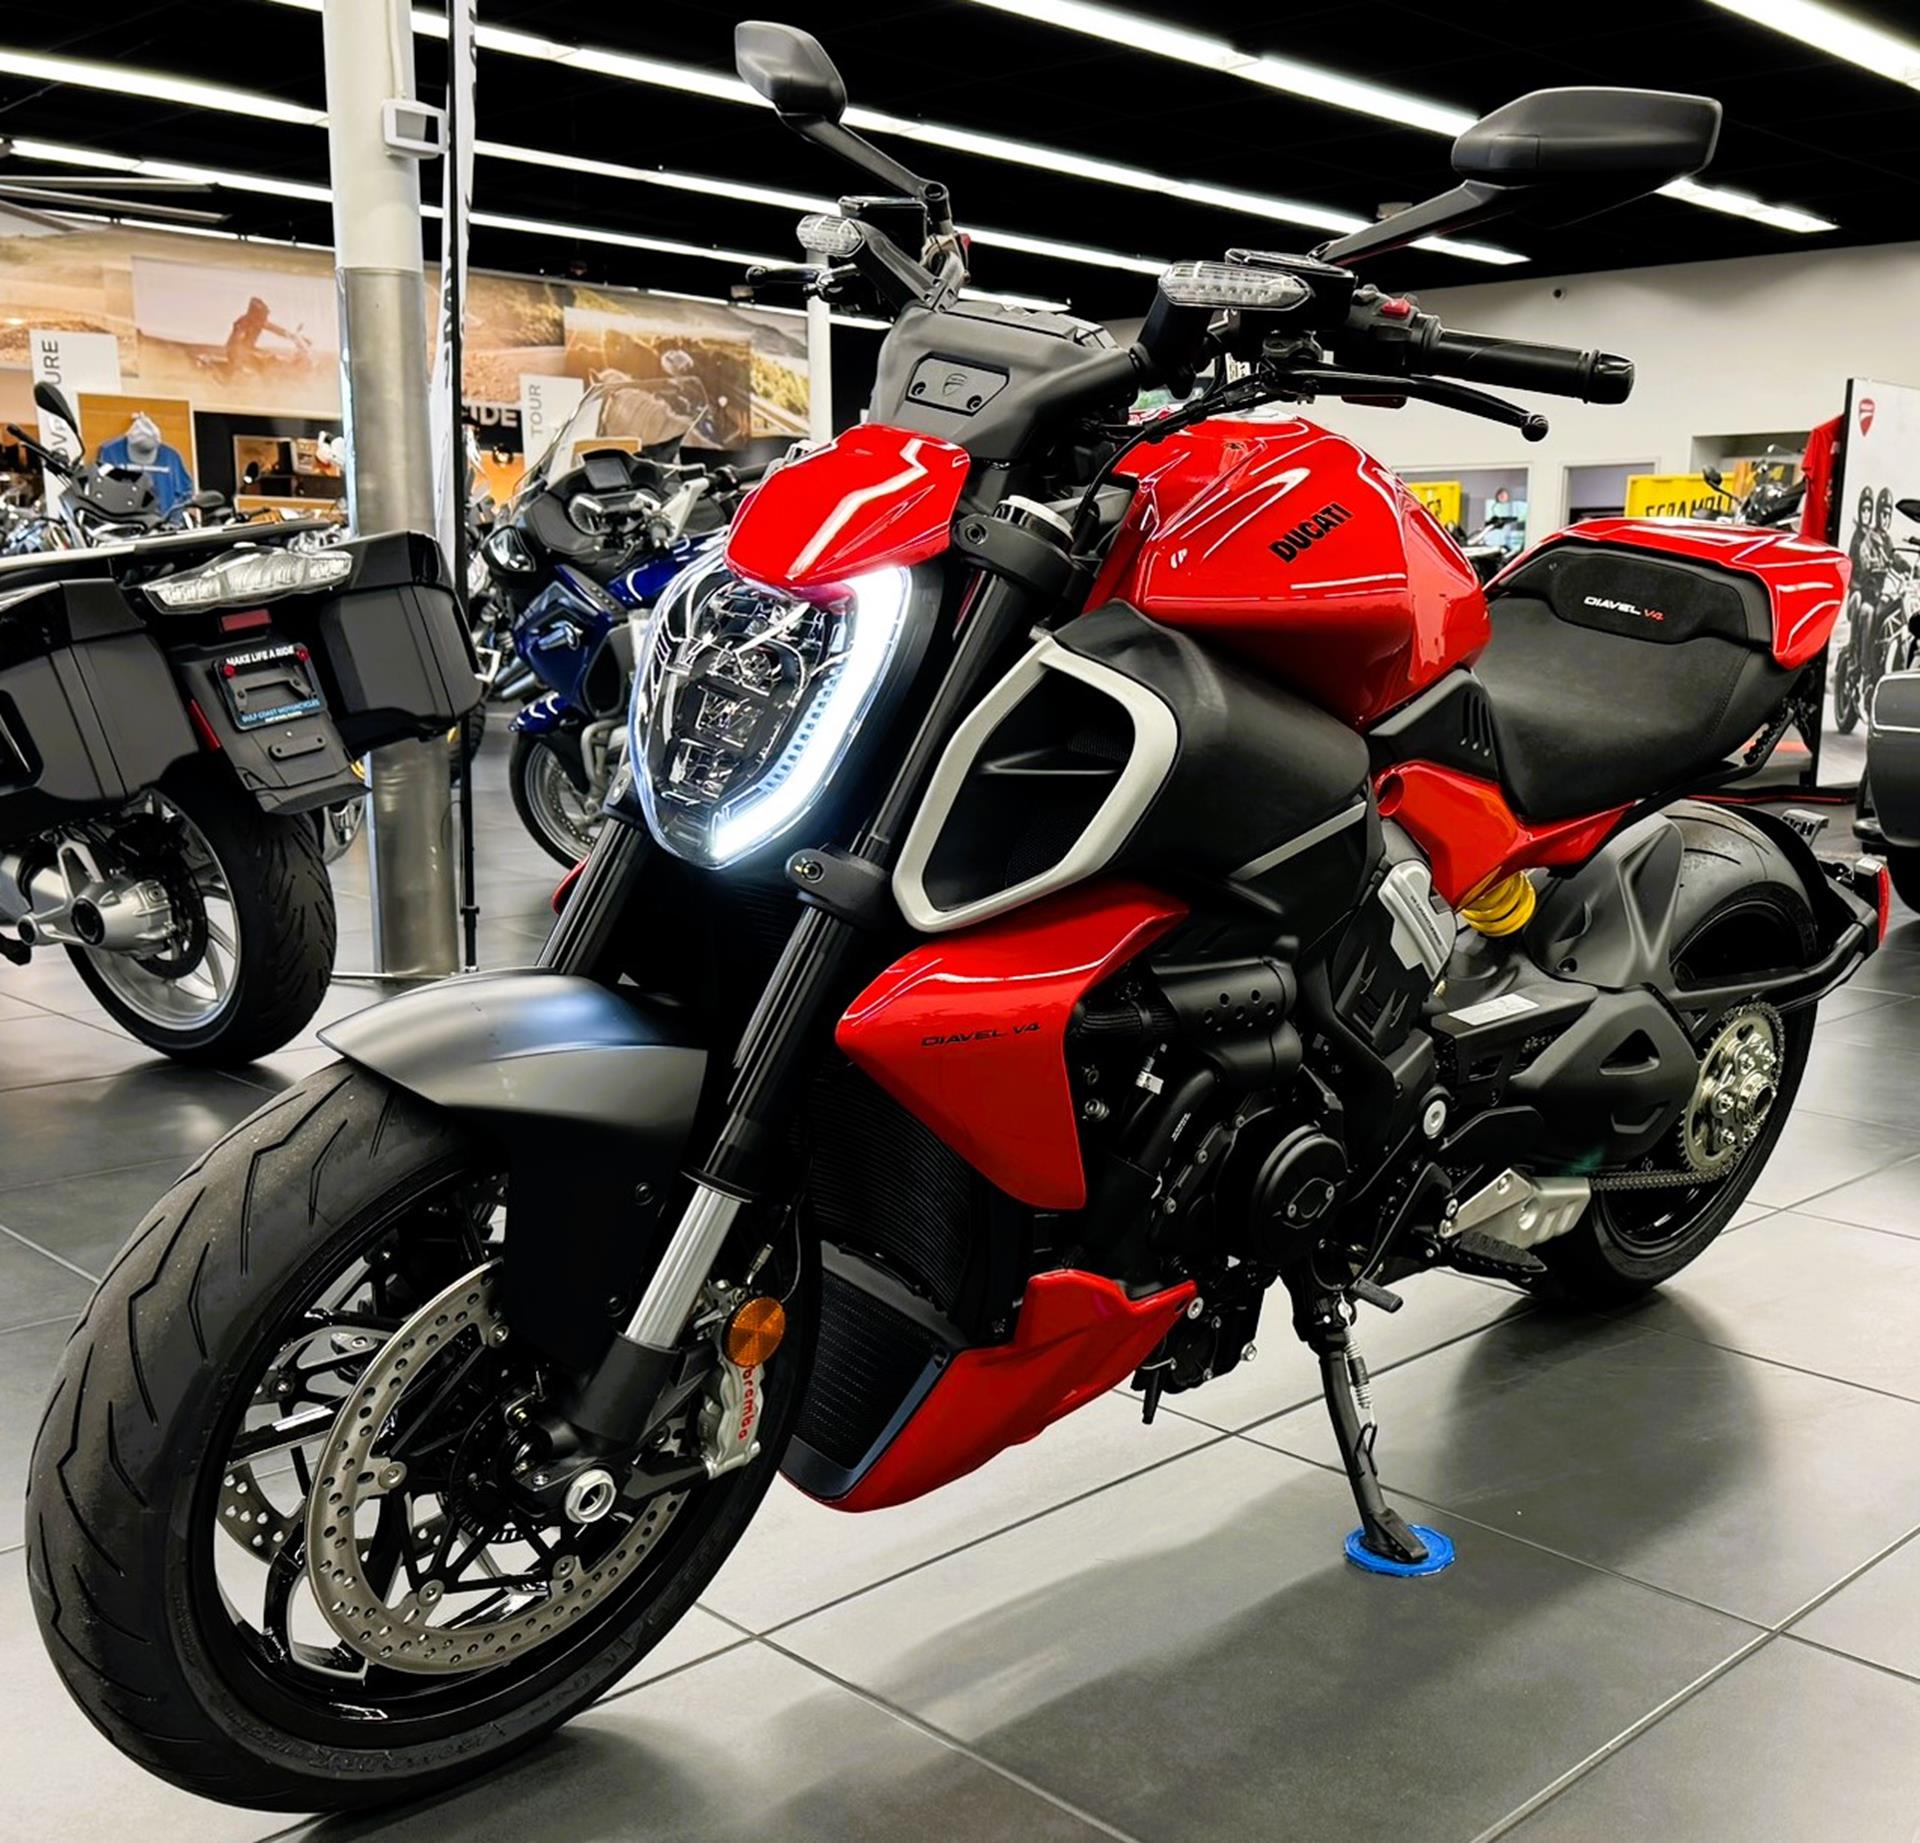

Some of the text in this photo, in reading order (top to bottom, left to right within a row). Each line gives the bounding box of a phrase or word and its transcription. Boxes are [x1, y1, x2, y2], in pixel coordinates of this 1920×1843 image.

[529, 384, 543, 438] TOUR
[1268, 501, 1353, 563] DUCATI
[1584, 596, 1665, 622] DIAVEL V4
[226, 645, 295, 666] MAKE LIFE A RIDE
[922, 1029, 1007, 1047] DIAVEL
